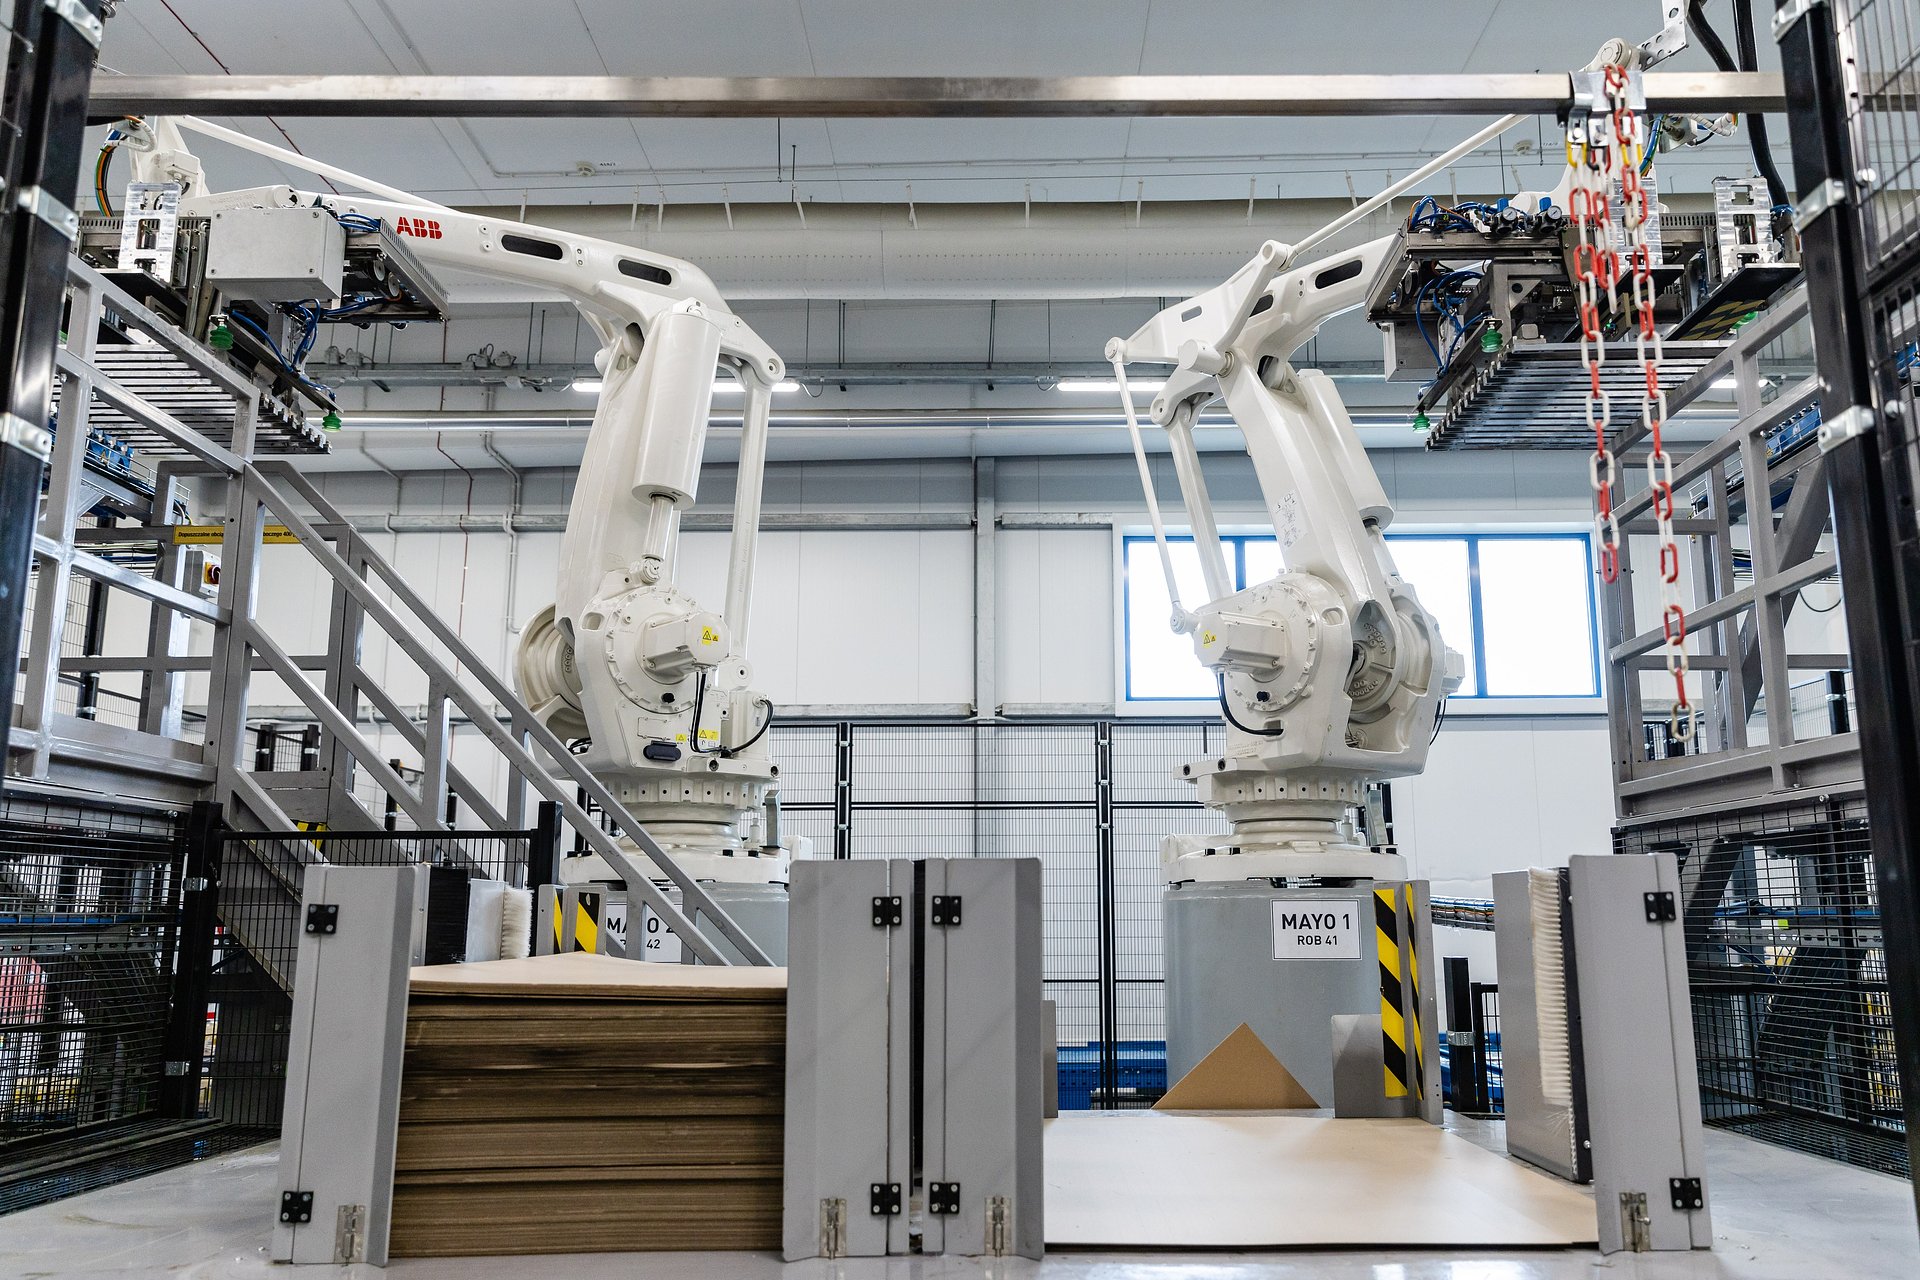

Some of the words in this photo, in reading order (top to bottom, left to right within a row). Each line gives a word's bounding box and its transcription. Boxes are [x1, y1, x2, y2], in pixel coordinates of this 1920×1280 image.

[396, 216, 443, 240] ABB
[607, 917, 660, 934] MO
[1281, 913, 1336, 930] MAYO
[1342, 913, 1350, 930] 1
[646, 938, 661, 950] 42
[1297, 935, 1322, 946] ROB
[1325, 935, 1338, 946] 41
